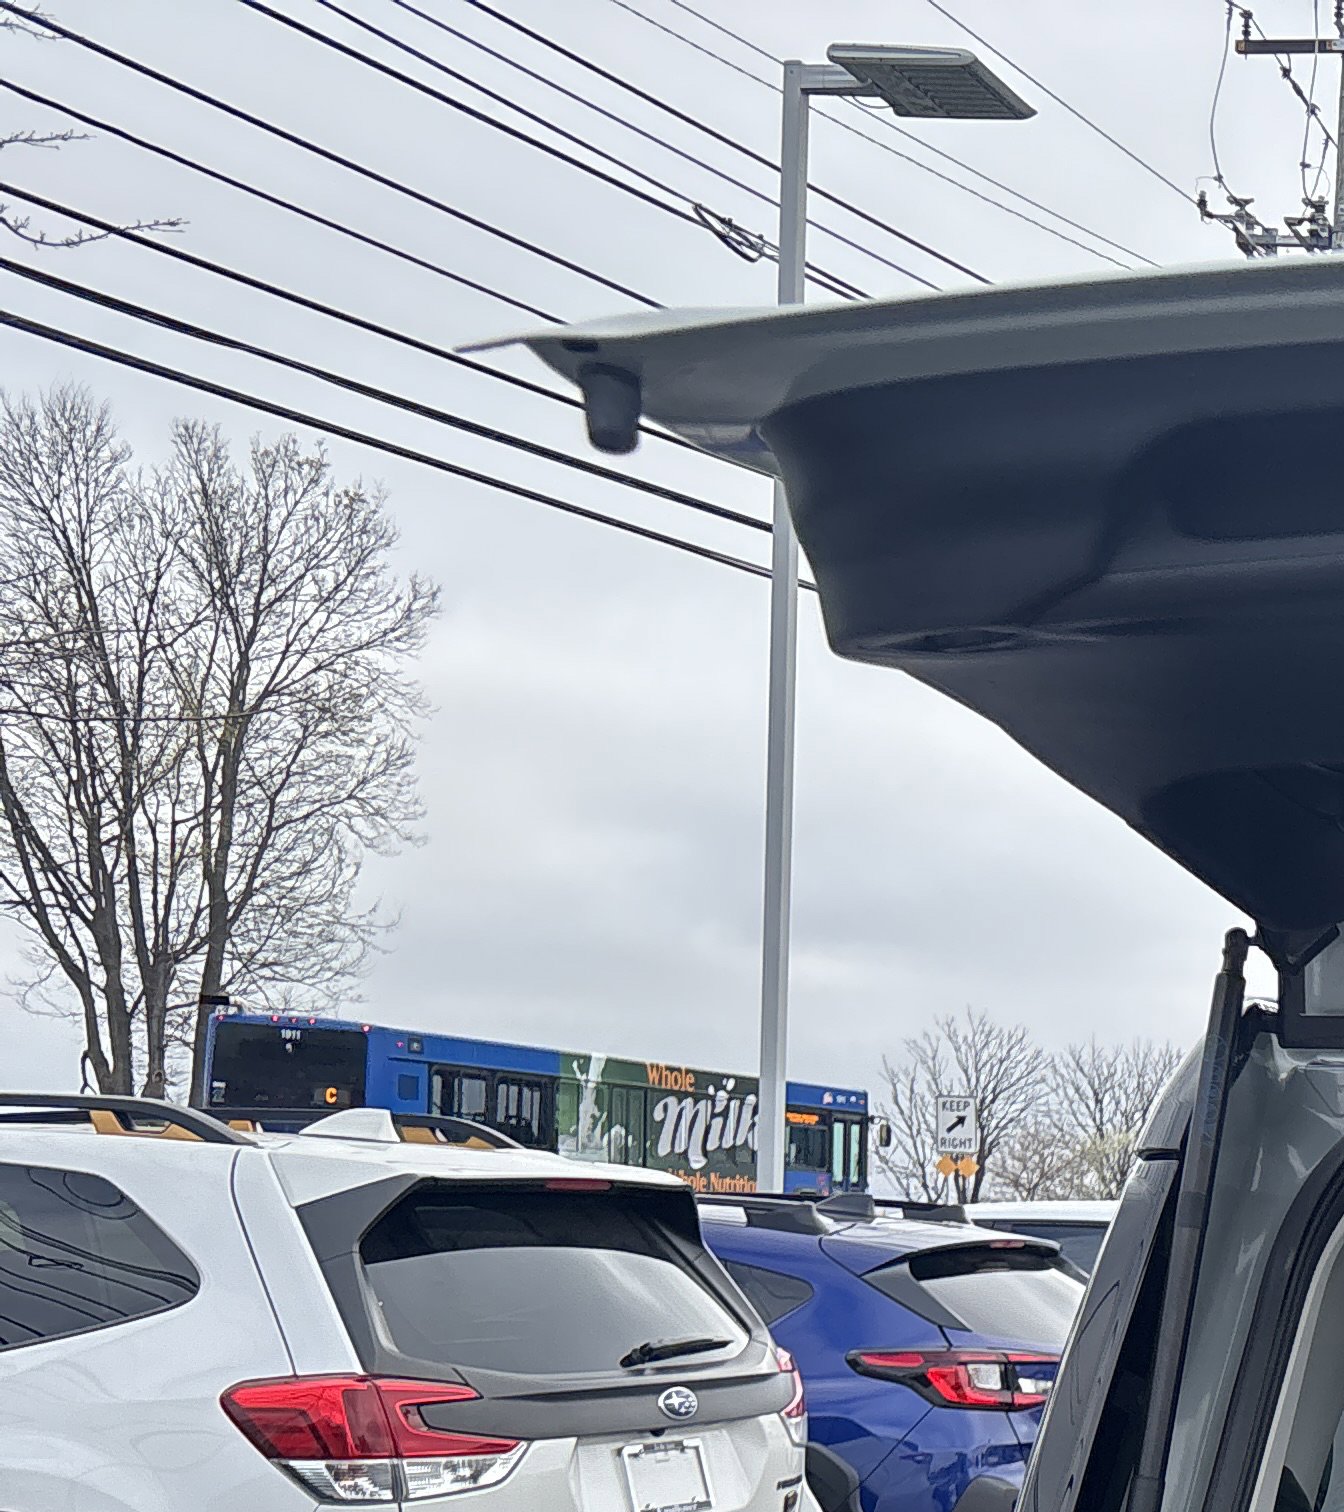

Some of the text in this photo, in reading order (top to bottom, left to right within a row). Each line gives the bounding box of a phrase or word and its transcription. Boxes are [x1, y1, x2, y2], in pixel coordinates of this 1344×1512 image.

[646, 1062, 696, 1092] Whole
[325, 1087, 337, 1104] C
[942, 1100, 970, 1113] KEEP
[940, 1137, 973, 1150] RIGHT
[709, 1171, 757, 1193] Nutritio
